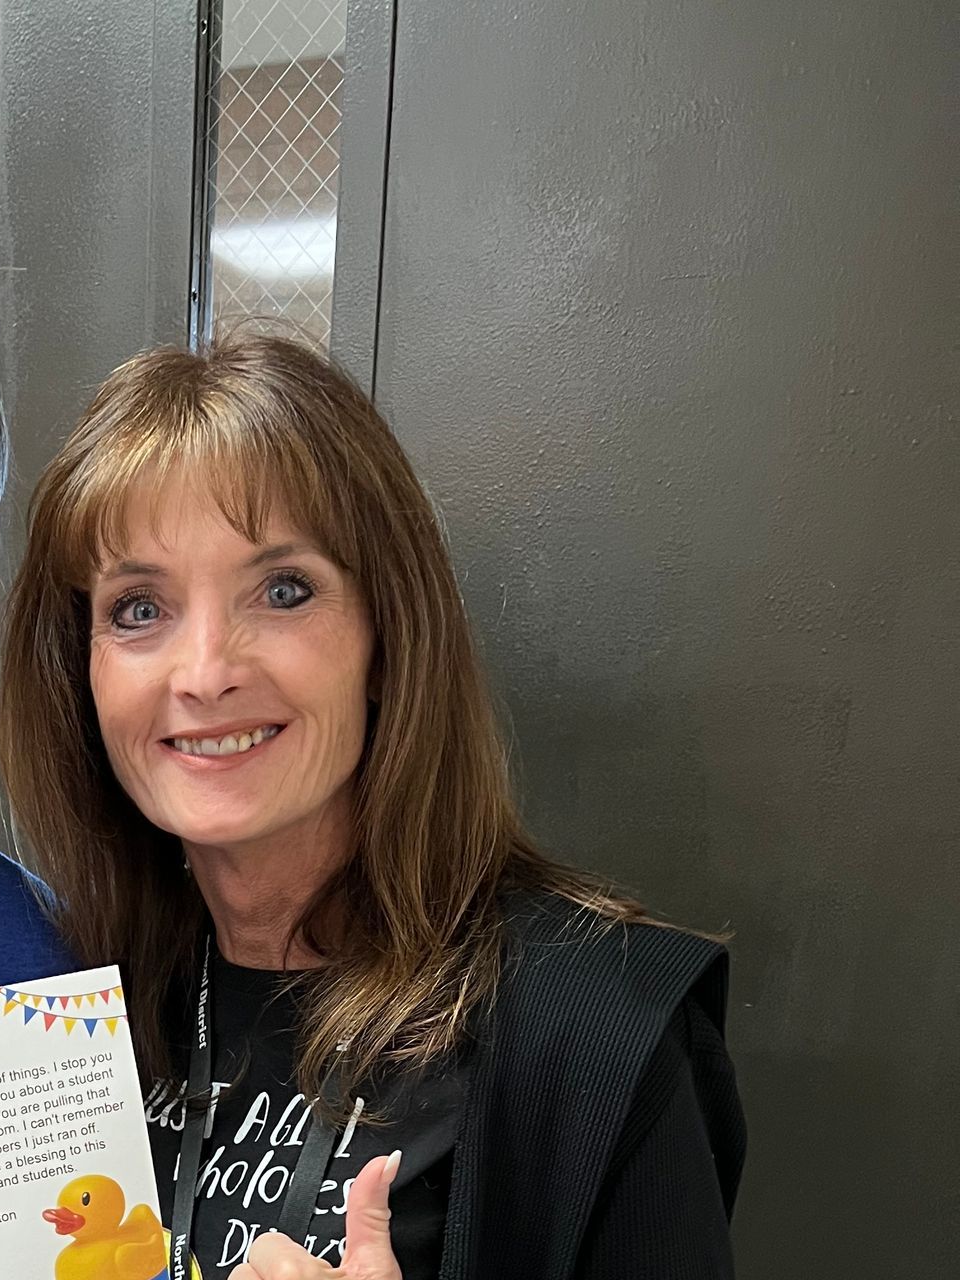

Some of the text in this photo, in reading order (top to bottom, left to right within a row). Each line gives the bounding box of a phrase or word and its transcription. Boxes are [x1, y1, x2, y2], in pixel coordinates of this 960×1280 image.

[9, 1066, 50, 1081] things.
[53, 1062, 57, 1072] I
[61, 1058, 87, 1071] stop
[90, 1052, 112, 1067] you
[19, 1081, 54, 1097] about
[57, 1080, 65, 1089] a
[68, 1067, 114, 1087] student
[20, 1102, 40, 1115] are
[44, 1094, 84, 1112] pulling
[87, 1086, 111, 1101] that
[23, 1120, 27, 1131] I
[30, 1114, 60, 1129] can't
[62, 1100, 125, 1122] remember
[24, 1137, 28, 1148] I
[32, 1132, 54, 1149] just
[57, 1129, 77, 1140] ran
[80, 1122, 100, 1136] off.
[233, 1091, 270, 1145] A
[270, 1093, 365, 1158] GIL
[5, 1160, 13, 1170] a
[15, 1149, 67, 1168] blessing
[70, 1144, 81, 1156] to
[84, 1140, 106, 1153] this
[22, 1163, 78, 1183] students.
[173, 1145, 357, 1215] ho loes
